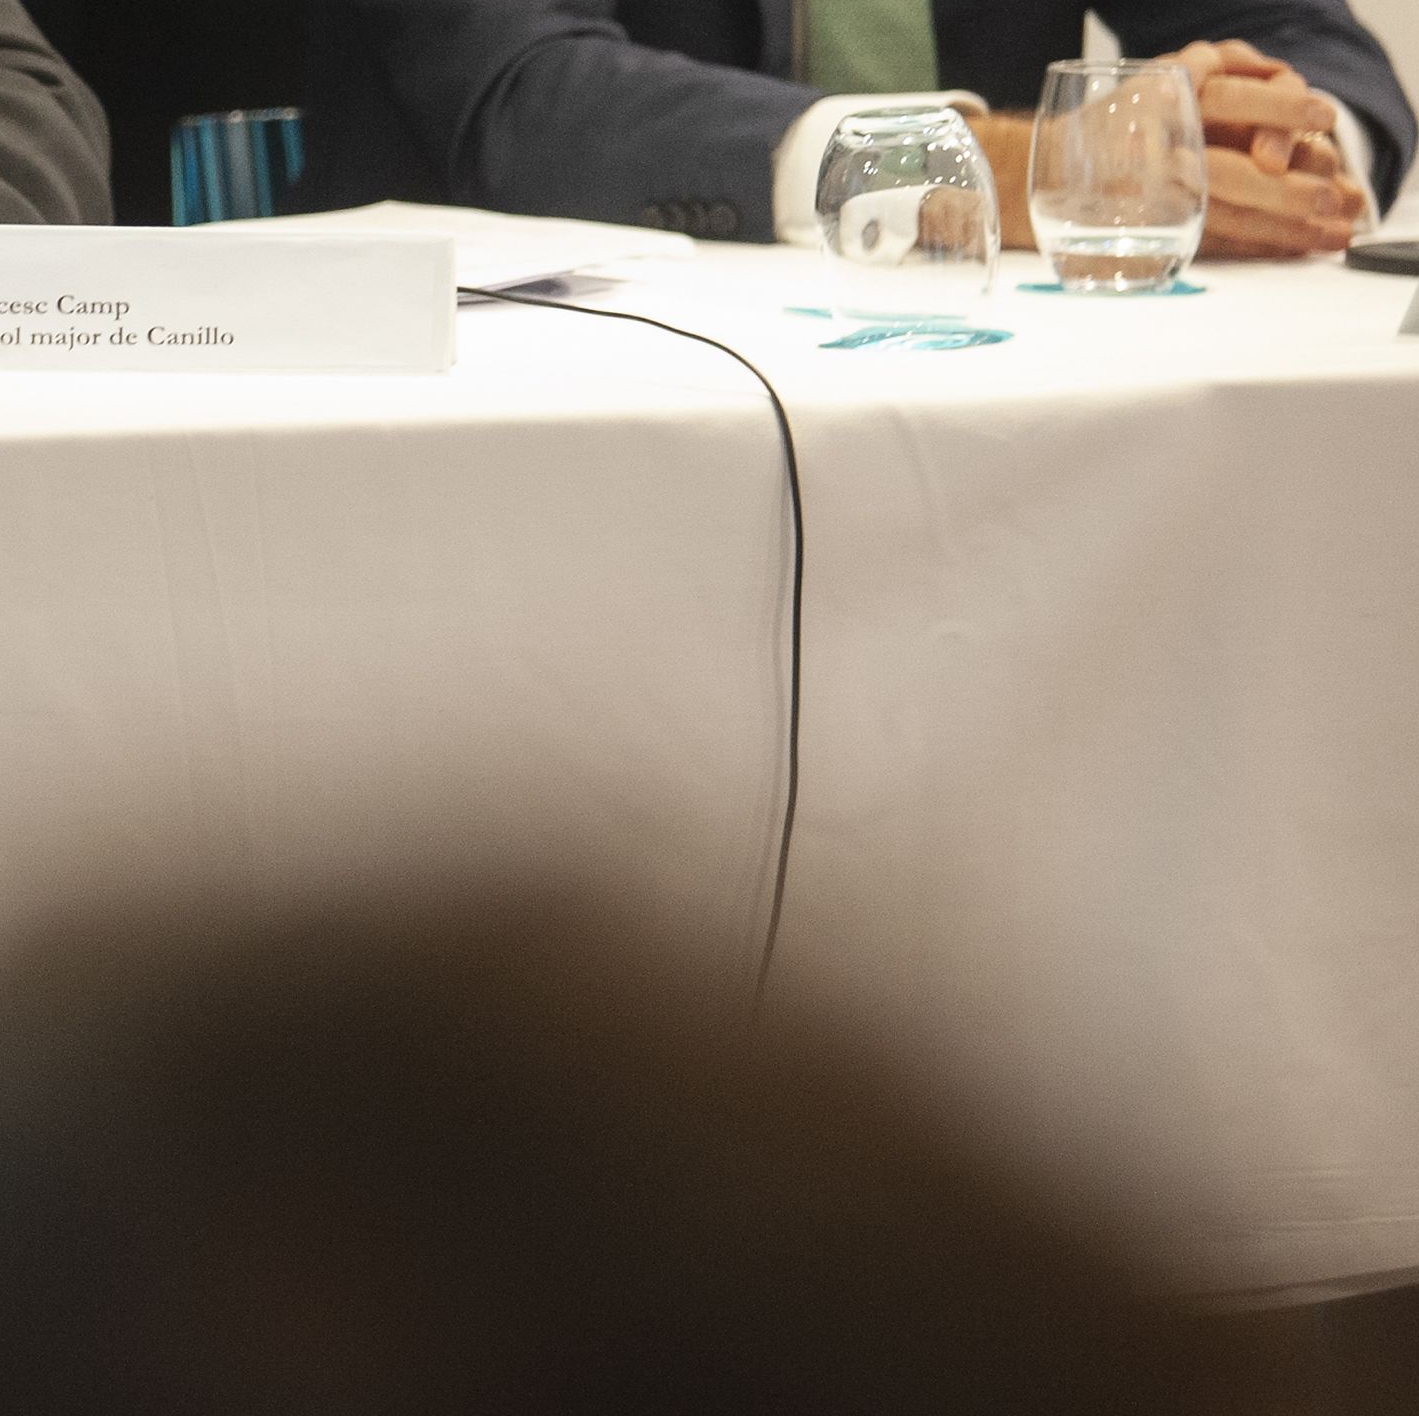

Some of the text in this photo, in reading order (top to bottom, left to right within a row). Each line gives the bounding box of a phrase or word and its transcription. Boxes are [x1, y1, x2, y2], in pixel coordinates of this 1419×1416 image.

[57, 294, 130, 320] Camp
[30, 326, 102, 351] major
[109, 326, 138, 345] de
[147, 326, 235, 346] Canillo
